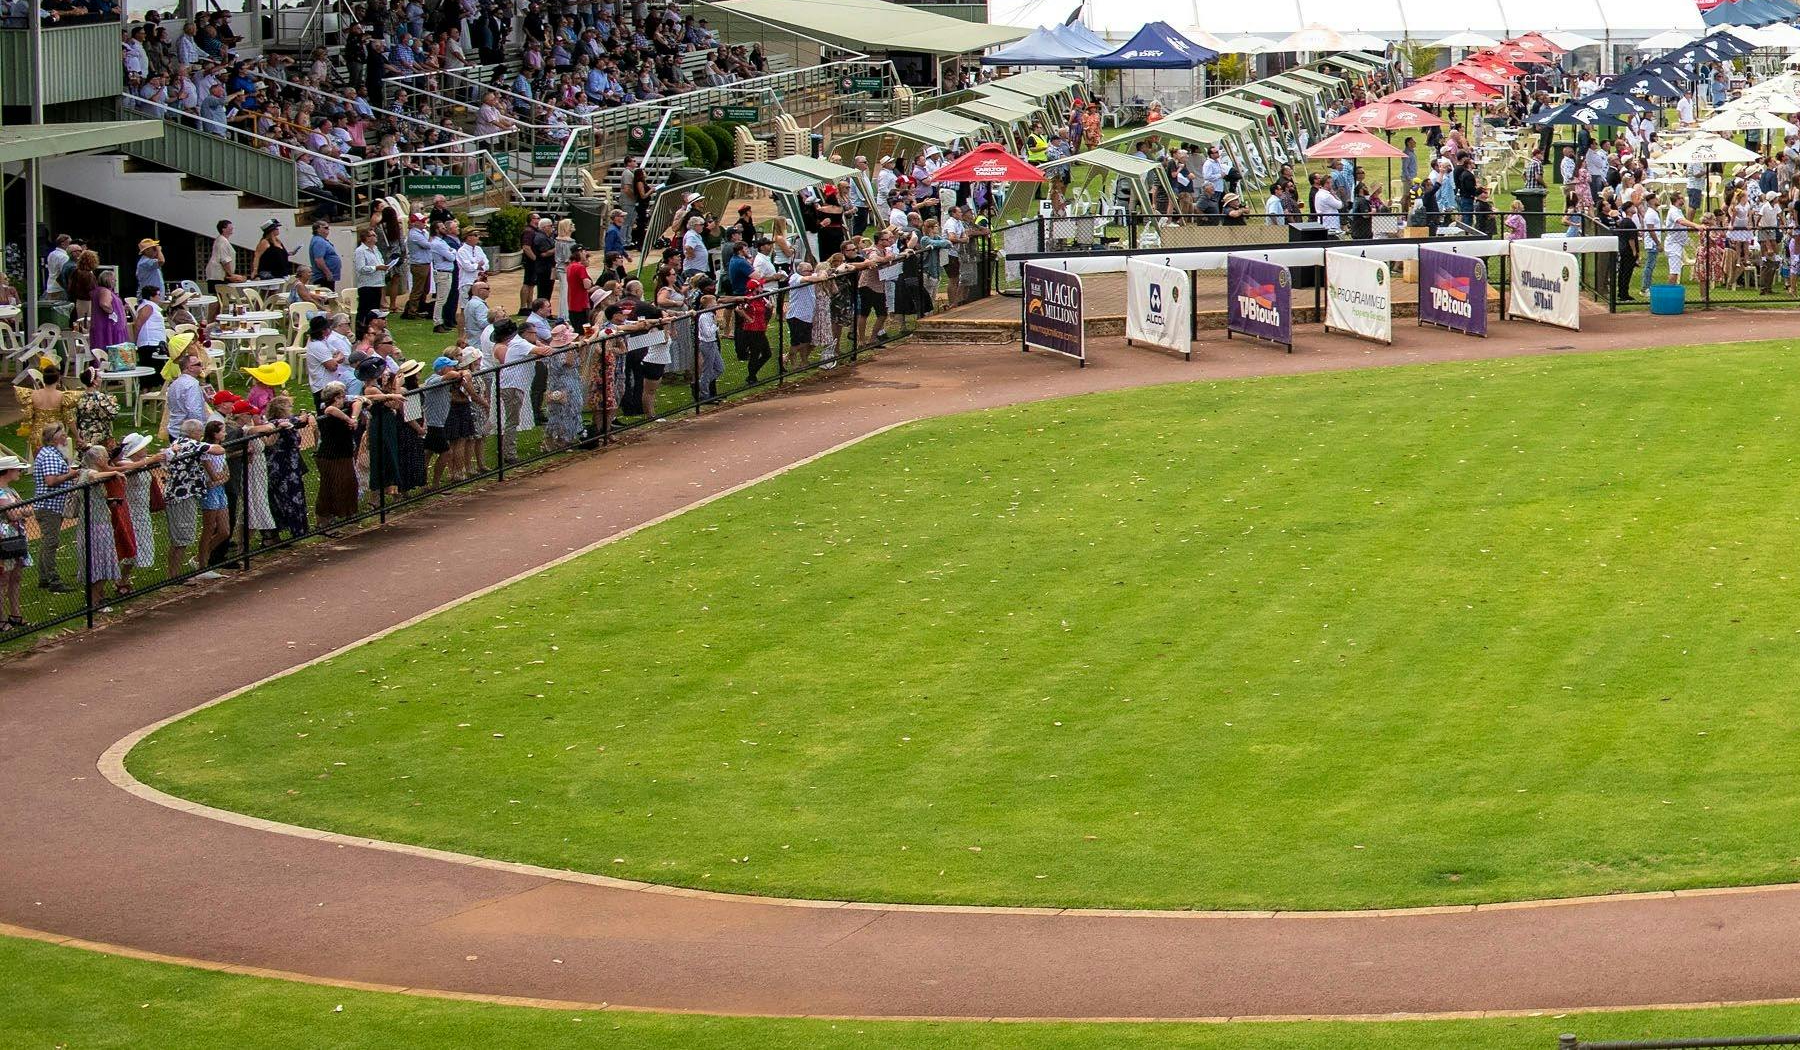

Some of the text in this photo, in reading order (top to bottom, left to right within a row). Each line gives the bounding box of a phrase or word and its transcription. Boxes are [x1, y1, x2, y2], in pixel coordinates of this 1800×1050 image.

[1360, 250, 1366, 258] 4
[1562, 242, 1568, 251] 6
[1063, 260, 1067, 271] 1
[1165, 257, 1171, 267] 2
[1263, 254, 1269, 262] 3
[1521, 270, 1561, 294] Mandurah
[1044, 279, 1078, 309] MAGIC
[1337, 287, 1386, 310] PROGRAMMED
[1534, 292, 1553, 310] Mail
[1044, 303, 1079, 326] MILLIONS
[1238, 295, 1280, 327] TABtouch
[1145, 313, 1166, 327] ALCOA
